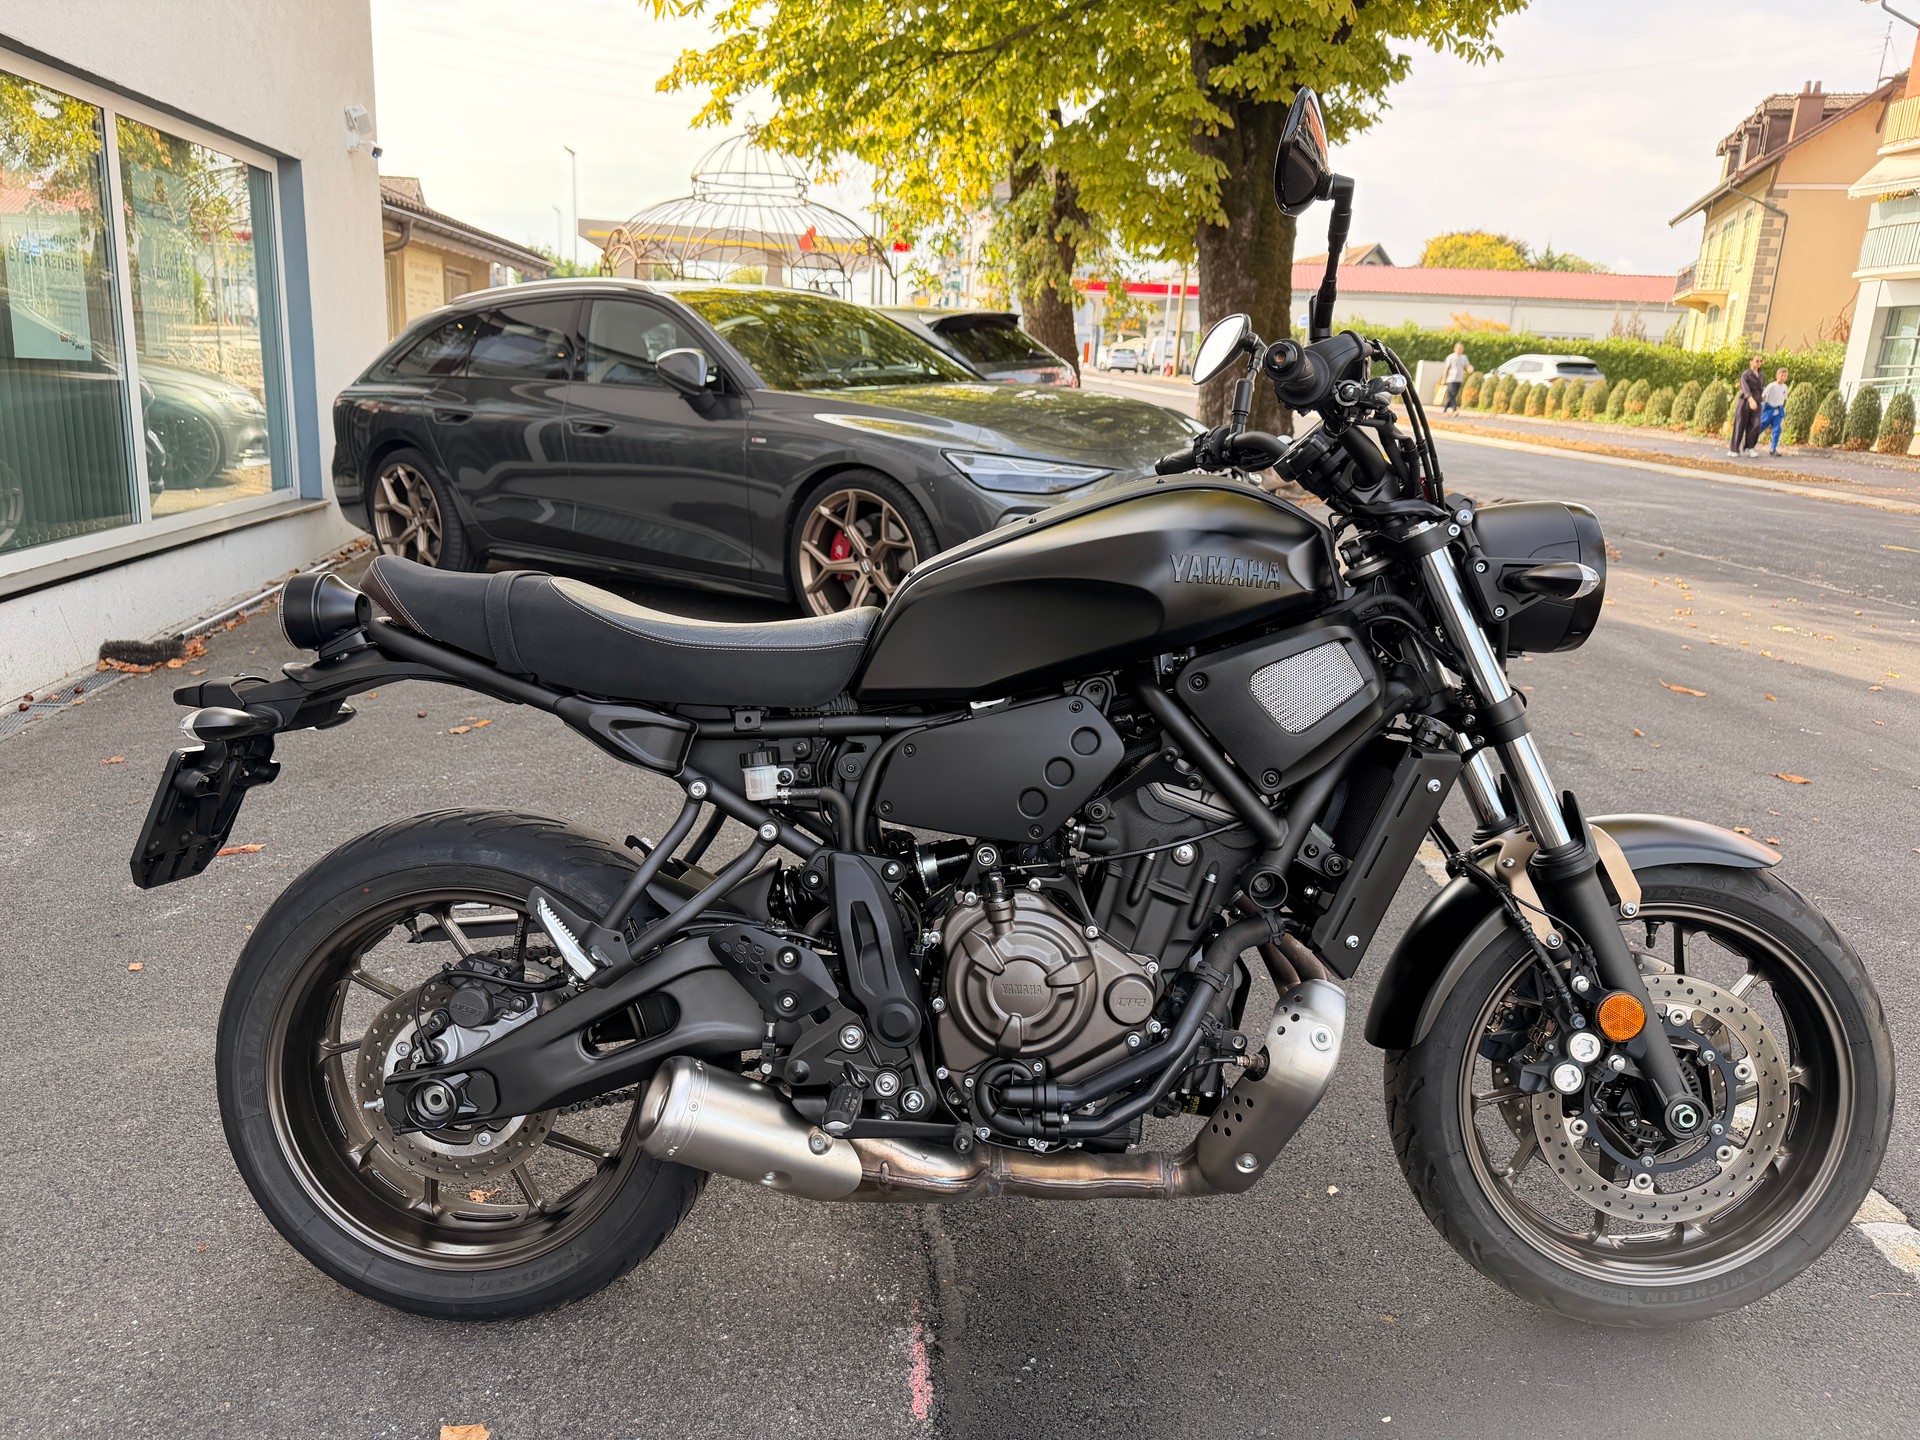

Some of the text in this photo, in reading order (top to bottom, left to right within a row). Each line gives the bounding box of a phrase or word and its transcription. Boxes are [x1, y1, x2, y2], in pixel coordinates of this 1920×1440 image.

[1169, 554, 1281, 591] YAMAHA
[1001, 983, 1043, 996] YAMAHA
[1547, 1268, 1622, 1300] 120/70 ZR 17
[1644, 1270, 1747, 1303] MICHELIN
